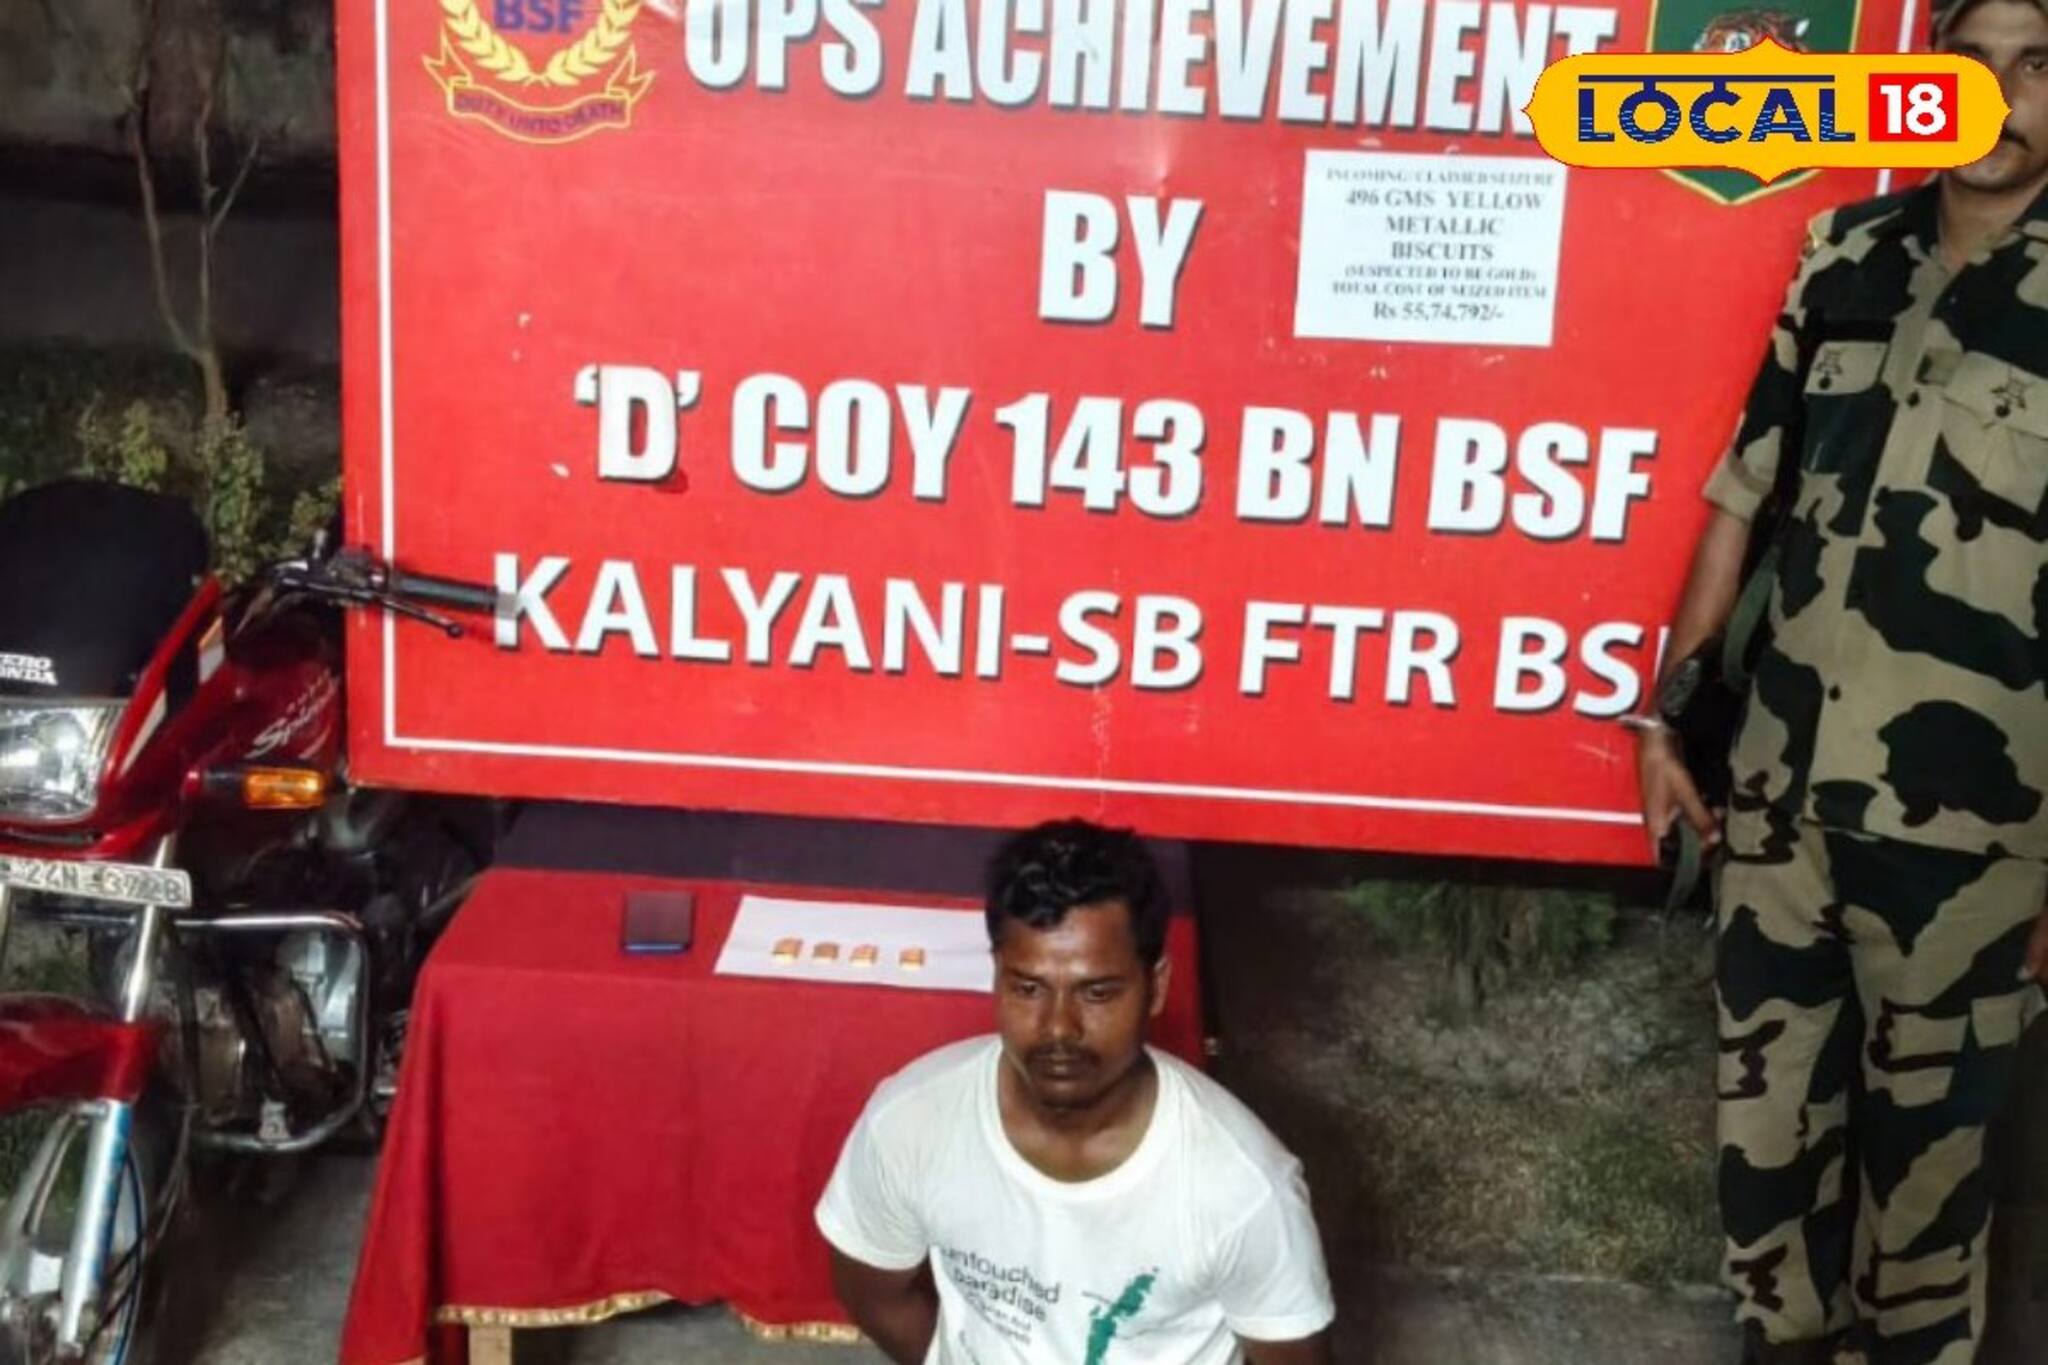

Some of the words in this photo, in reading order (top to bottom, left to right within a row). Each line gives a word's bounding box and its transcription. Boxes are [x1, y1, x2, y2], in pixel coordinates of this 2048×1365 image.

[1346, 188, 1380, 207] 496
[1384, 189, 1435, 208] GMS
[1446, 191, 1543, 210] YELLOW
[1386, 215, 1502, 235] METALLIC
[1040, 190, 1203, 328] BY
[1391, 241, 1494, 261] BISCUITS
[1373, 301, 1397, 319] Rs
[730, 372, 974, 500] COY
[993, 392, 1208, 520] 143
[1236, 405, 1402, 529] BN
[1427, 416, 1658, 545] BSF
[493, 552, 1204, 690] KALYANI-SB
[1238, 600, 1463, 709] FTR
[1493, 616, 1669, 719] BS
